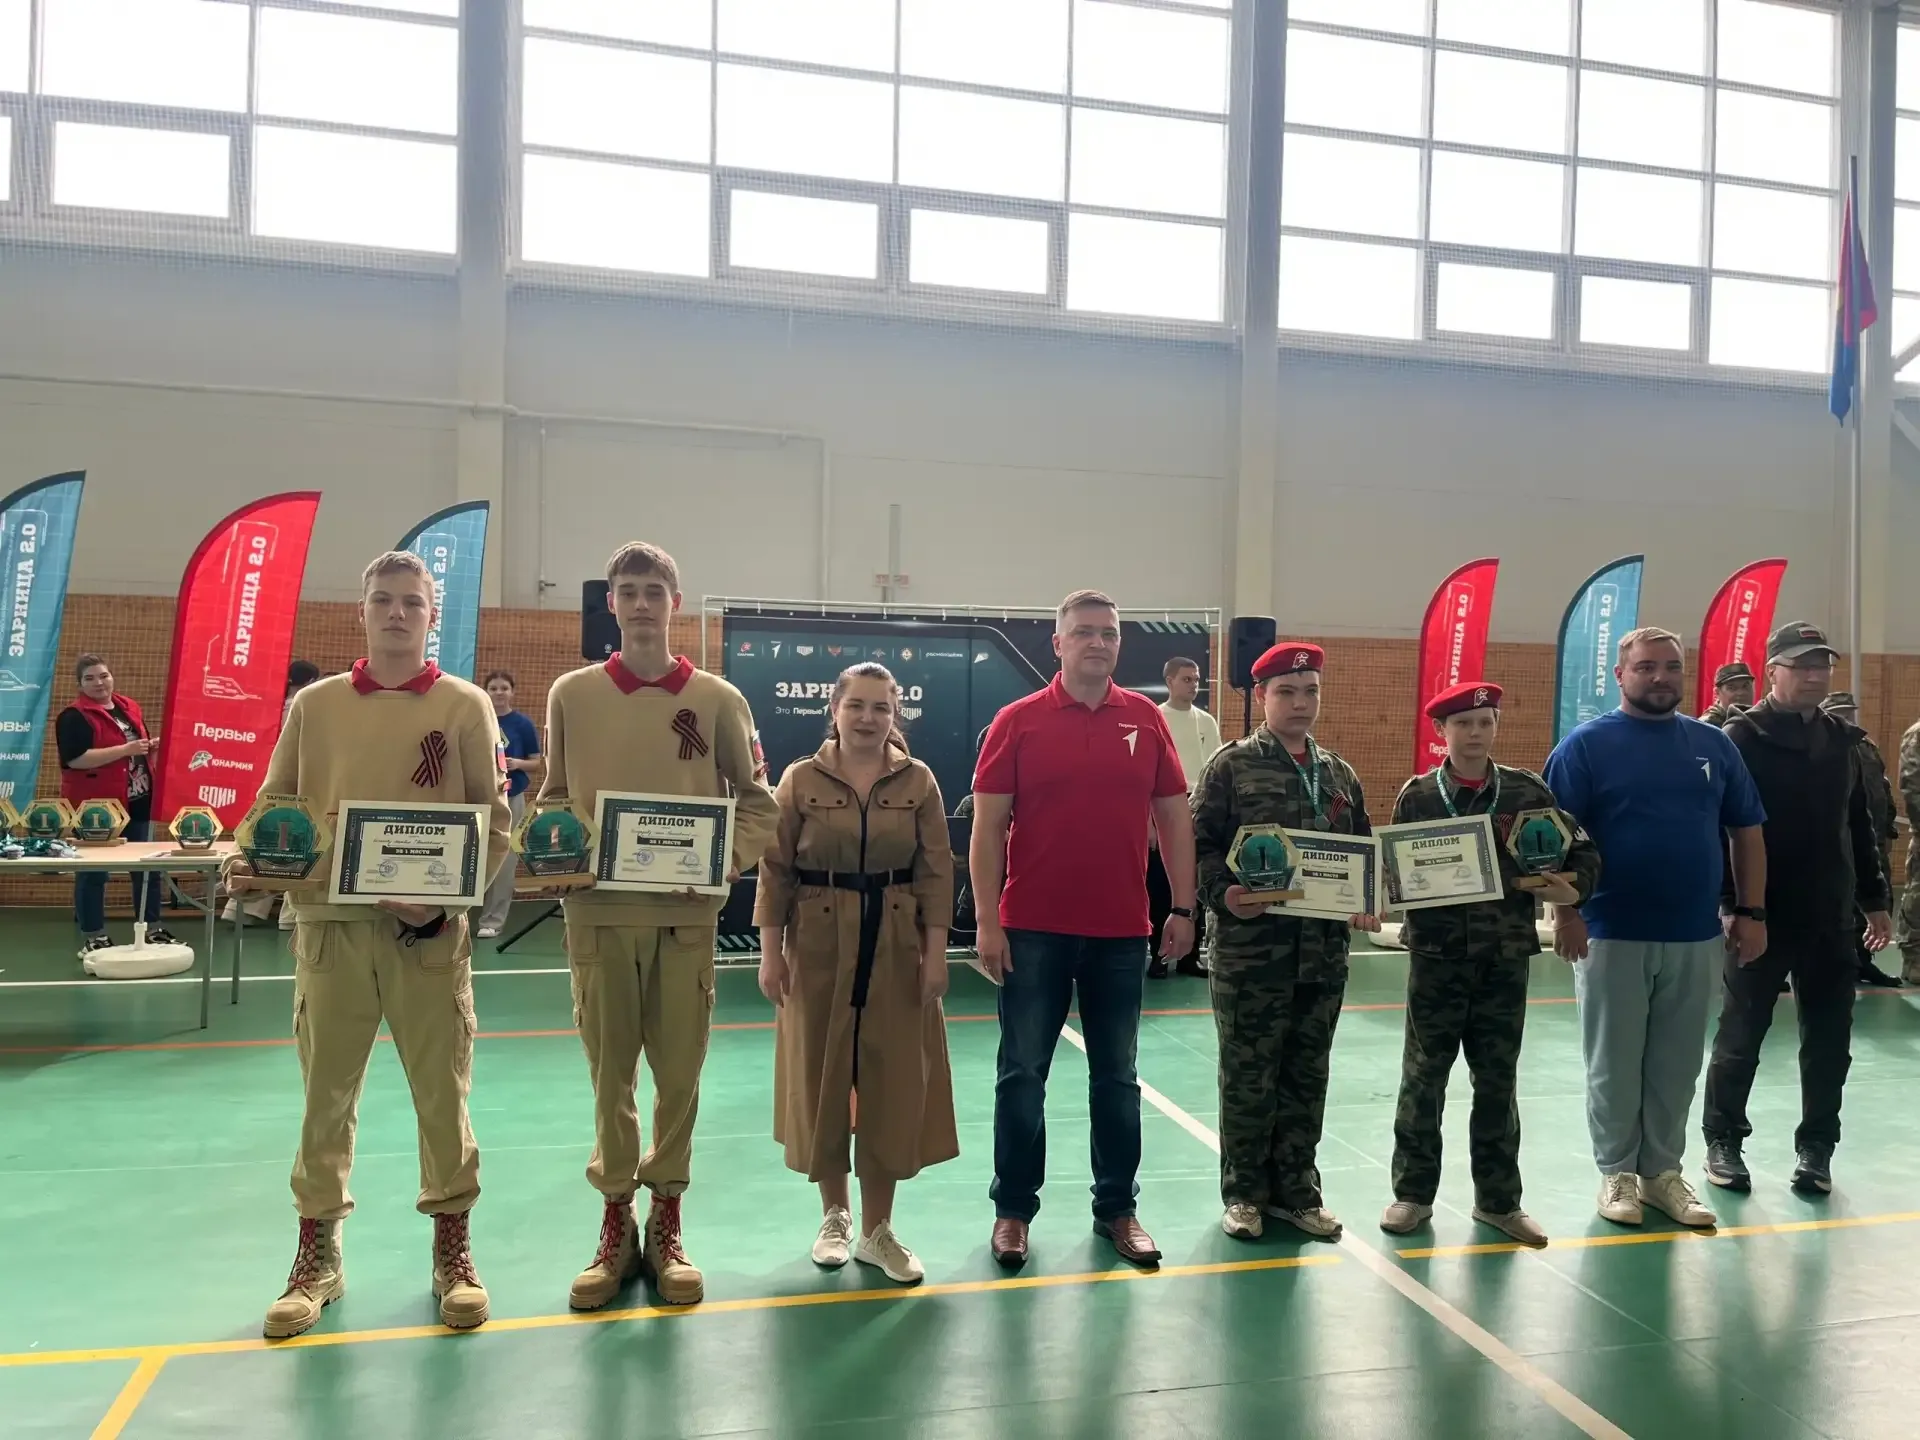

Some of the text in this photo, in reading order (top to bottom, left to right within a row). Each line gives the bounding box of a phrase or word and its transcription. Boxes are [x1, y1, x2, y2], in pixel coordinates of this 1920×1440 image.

[20, 523, 37, 553] 2.0
[433, 546, 448, 573] 2.0
[8, 559, 35, 657] ЗАРНИЦА
[233, 571, 261, 667] ЗАРНИЦА
[248, 536, 267, 566] 2.0
[1742, 590, 1755, 613] 2.0
[1450, 593, 1469, 687] АРНИЦА 2.0
[1596, 594, 1612, 697] ЗАРНИЦА 2.0
[775, 682, 923, 701] ЗАРН 2.0
[775, 706, 824, 717] Это Первые
[193, 722, 257, 743] Первые
[0, 752, 30, 761] НАРМИЯ
[211, 759, 254, 772] ЮНАРМИЯ
[198, 785, 237, 809] ВОИН
[383, 824, 446, 836] ДИПЛОМ
[638, 816, 696, 828] ДИПЛОМ
[1411, 836, 1461, 851] ДИПЛОМ
[1301, 851, 1349, 863] ДИПЛОМ
